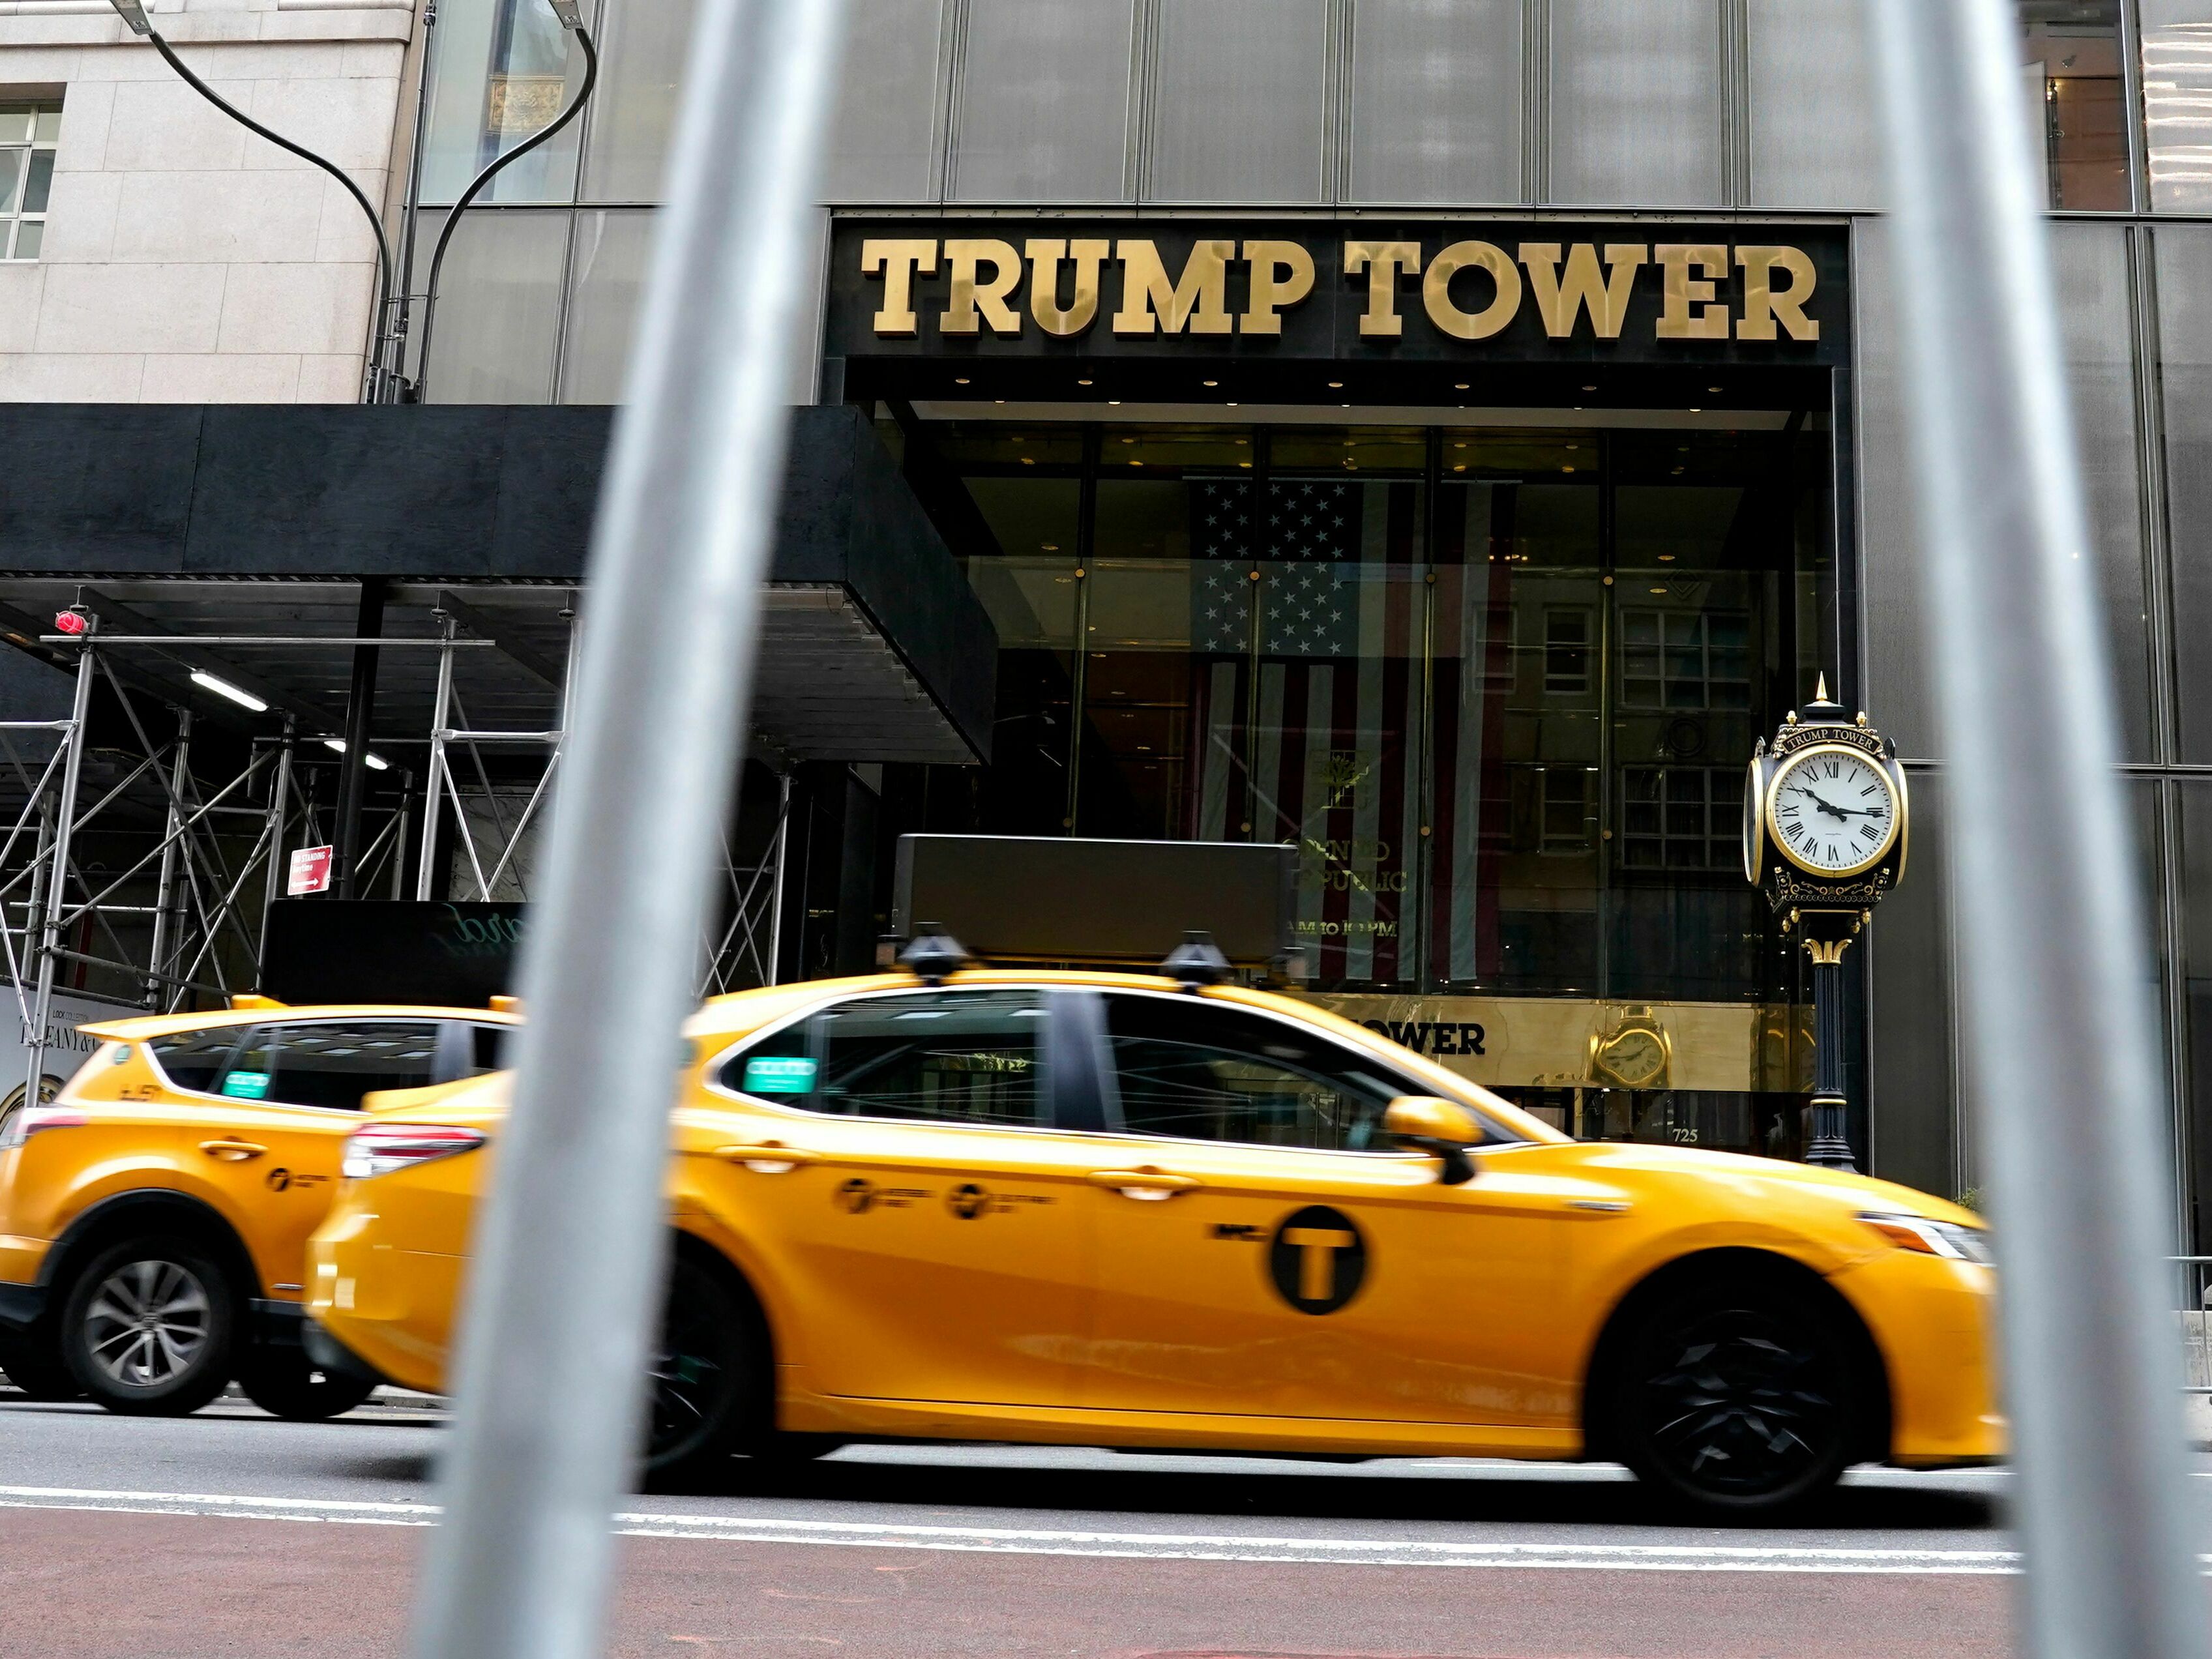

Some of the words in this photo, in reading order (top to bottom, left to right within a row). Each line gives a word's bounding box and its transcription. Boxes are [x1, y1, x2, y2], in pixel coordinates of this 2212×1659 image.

[861, 239, 1316, 337] TRUMP
[1344, 240, 1820, 340] TOWER
[1787, 729, 1828, 748] TRUMP
[1833, 729, 1873, 749] TOWER
[1866, 808, 1883, 817] II
[301, 851, 325, 862] STANDING
[1351, 1019, 1485, 1055] OWER
[1672, 1128, 1698, 1143] 725
